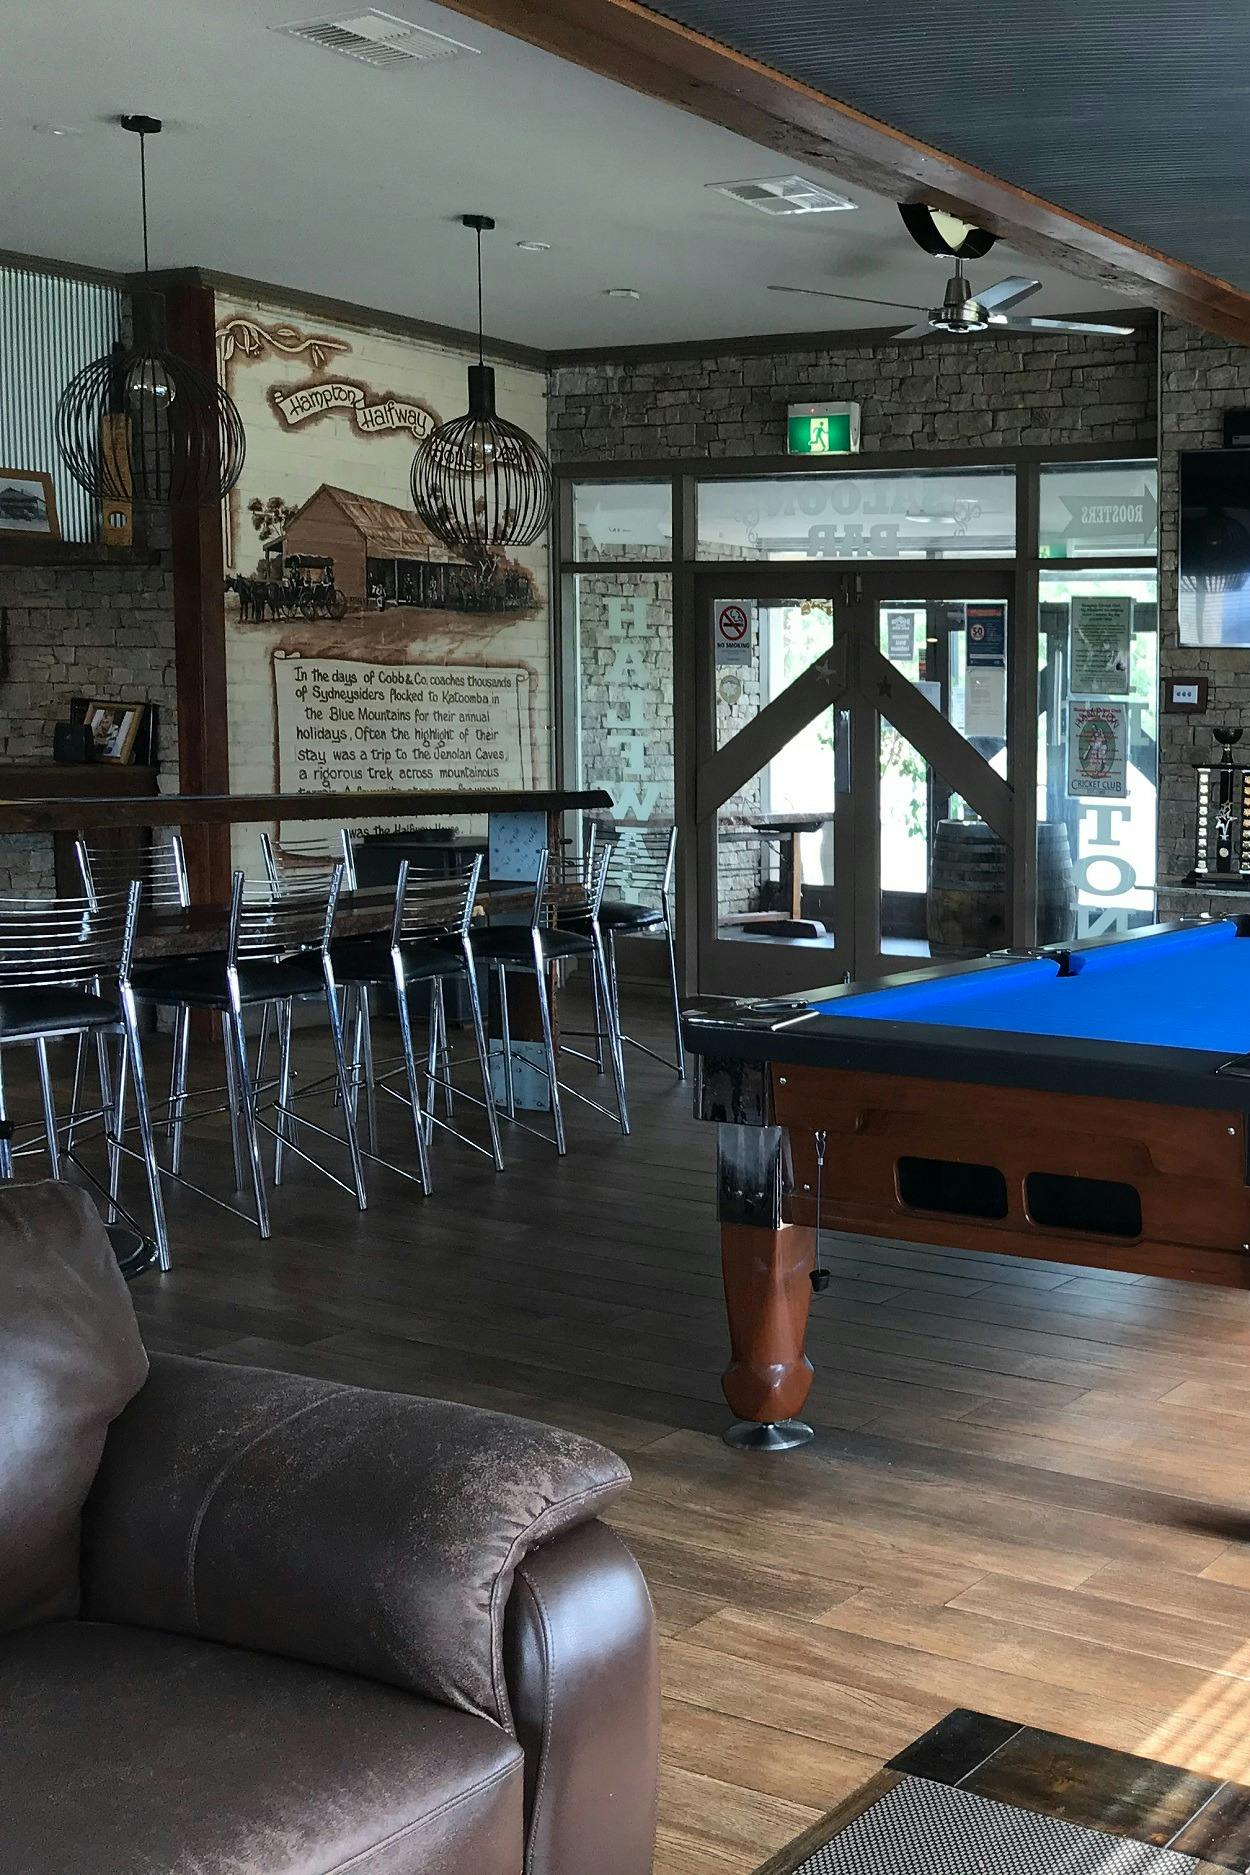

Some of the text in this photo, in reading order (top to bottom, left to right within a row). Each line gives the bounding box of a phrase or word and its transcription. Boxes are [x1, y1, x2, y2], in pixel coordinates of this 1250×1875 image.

[290, 385, 356, 416] Hampton
[362, 402, 427, 436] Halfway
[294, 666, 308, 681] In
[311, 668, 329, 682] the
[332, 669, 357, 686] days
[363, 670, 375, 685] of
[430, 674, 465, 686] coaches
[467, 674, 512, 688] thousands
[295, 685, 500, 705] of Sydneysiders flocked to Katoomba in
[304, 706, 490, 723] the Blue Mountains for their annual
[354, 726, 387, 741] Often
[391, 727, 410, 740] the
[415, 727, 454, 748] highlight
[460, 727, 469, 743] of
[475, 728, 499, 741] their
[297, 748, 326, 764] stay
[333, 750, 356, 760] was
[360, 750, 368, 760] a
[371, 748, 392, 764] trip
[395, 748, 407, 760] to
[412, 747, 431, 760] the
[433, 747, 472, 760] Jenolan
[299, 769, 307, 780] a
[313, 766, 363, 789] rigorous
[367, 766, 394, 780] trek
[399, 768, 434, 779] across
[439, 766, 500, 778] mountainous
[1102, 781, 1122, 792] CLUB
[350, 828, 369, 839] was
